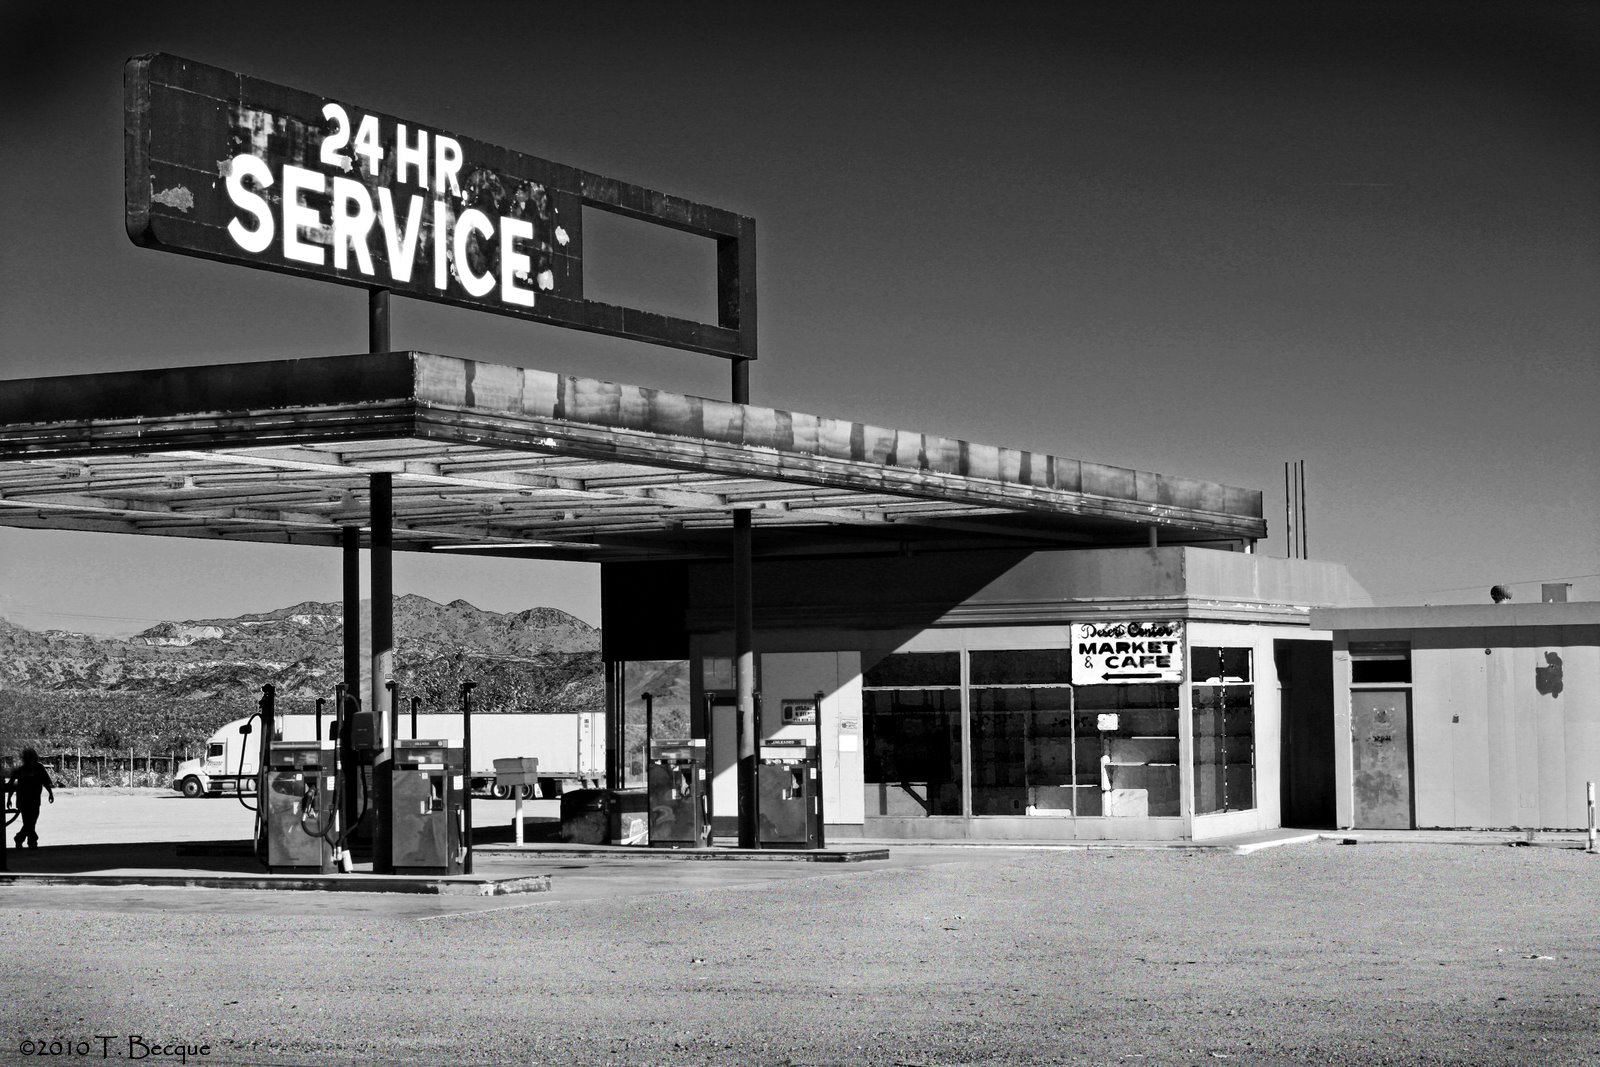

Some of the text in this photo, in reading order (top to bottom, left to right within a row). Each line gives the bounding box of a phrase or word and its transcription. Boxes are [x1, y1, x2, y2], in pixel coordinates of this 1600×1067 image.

[320, 102, 384, 176] 24
[225, 153, 536, 308] SERVICE
[1081, 622, 1174, 639] Desert Center
[1079, 641, 1178, 655] MARKET
[1084, 655, 1171, 669] & CAFE
